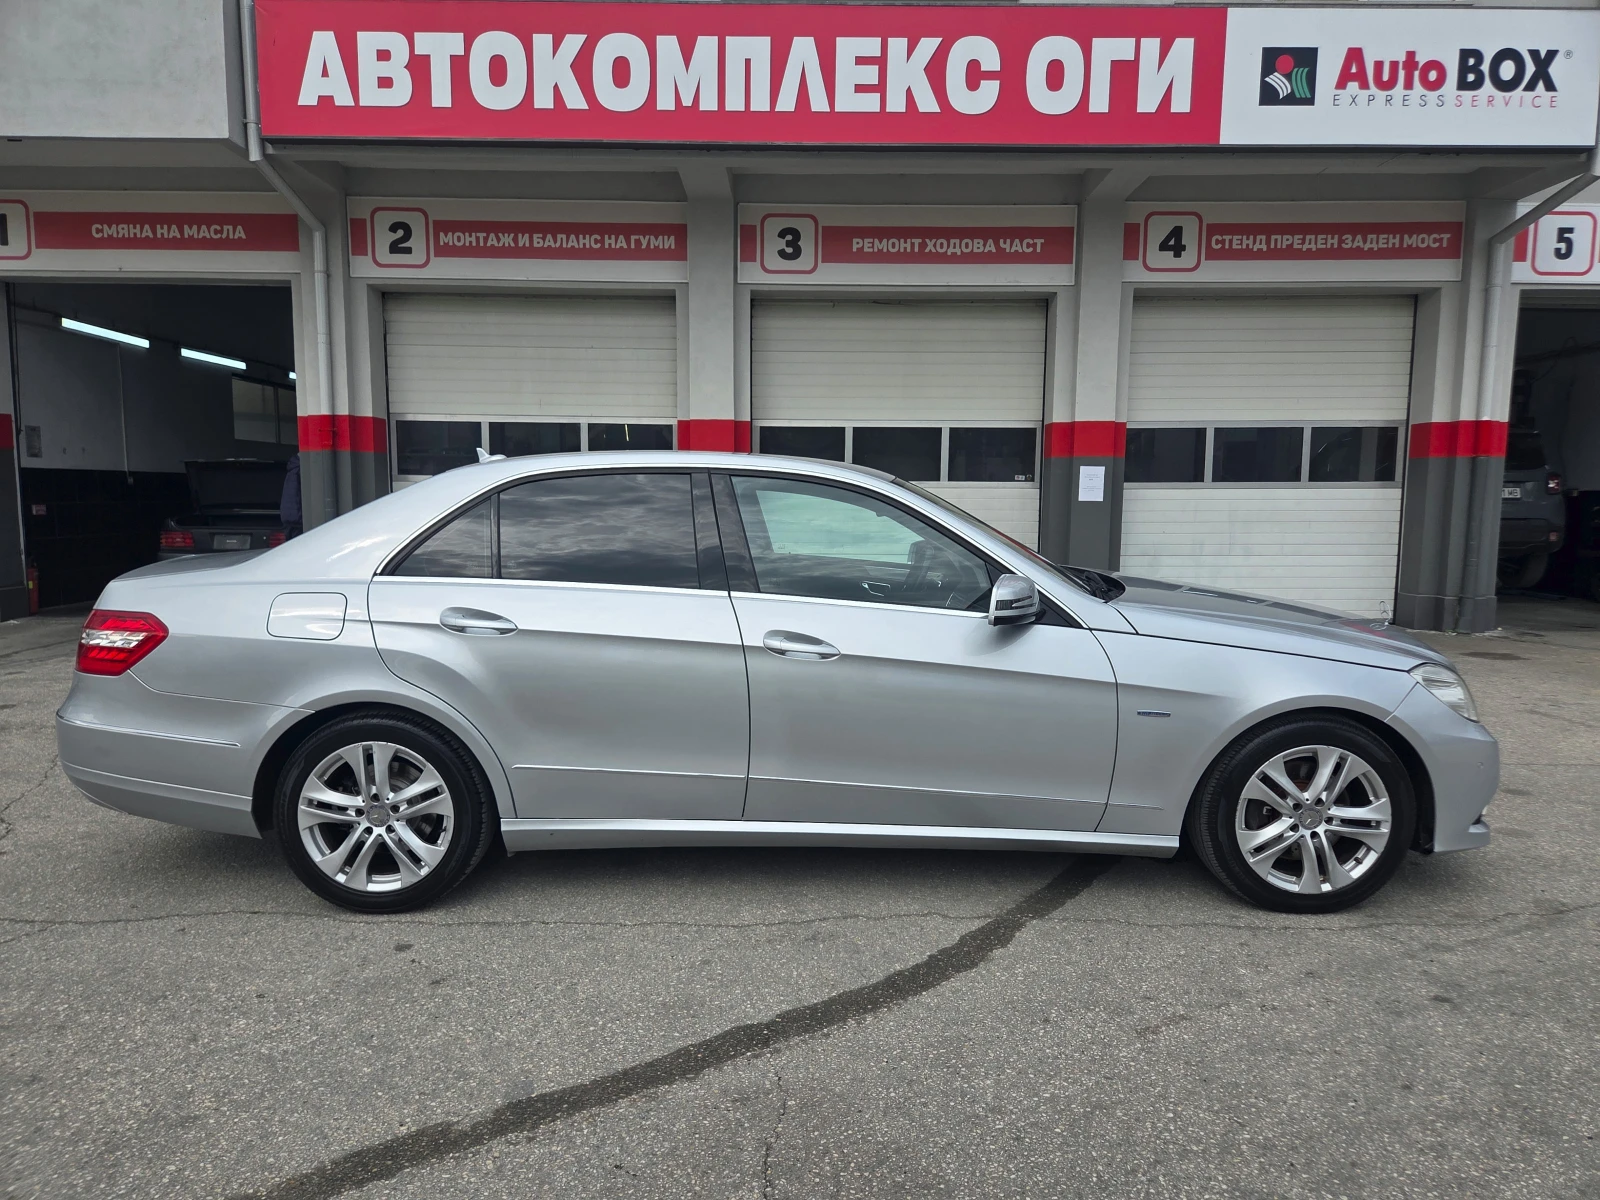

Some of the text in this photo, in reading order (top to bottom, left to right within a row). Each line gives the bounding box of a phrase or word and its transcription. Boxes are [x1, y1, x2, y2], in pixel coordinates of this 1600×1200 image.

[297, 30, 1195, 115] АВТОКОМПЛЕКС ОГИ
[1334, 47, 1560, 93] Auto BOX
[1333, 94, 1558, 109] EXPRESS SERVICE
[91, 223, 246, 240] СМЯНА НА МАСЛА
[387, 221, 413, 255] 2
[439, 232, 676, 250] МОНТАЖ И БАЛАНС НА ГУМИ
[777, 227, 803, 261] 3
[852, 238, 1044, 255] РЕМОНТ ХОДОВА ЧАСТ
[1158, 225, 1187, 259] 4
[1211, 233, 1451, 252] СТЕНД ПРЕДЕН ЗАДЕН МОСТ
[1553, 227, 1575, 261] 5
